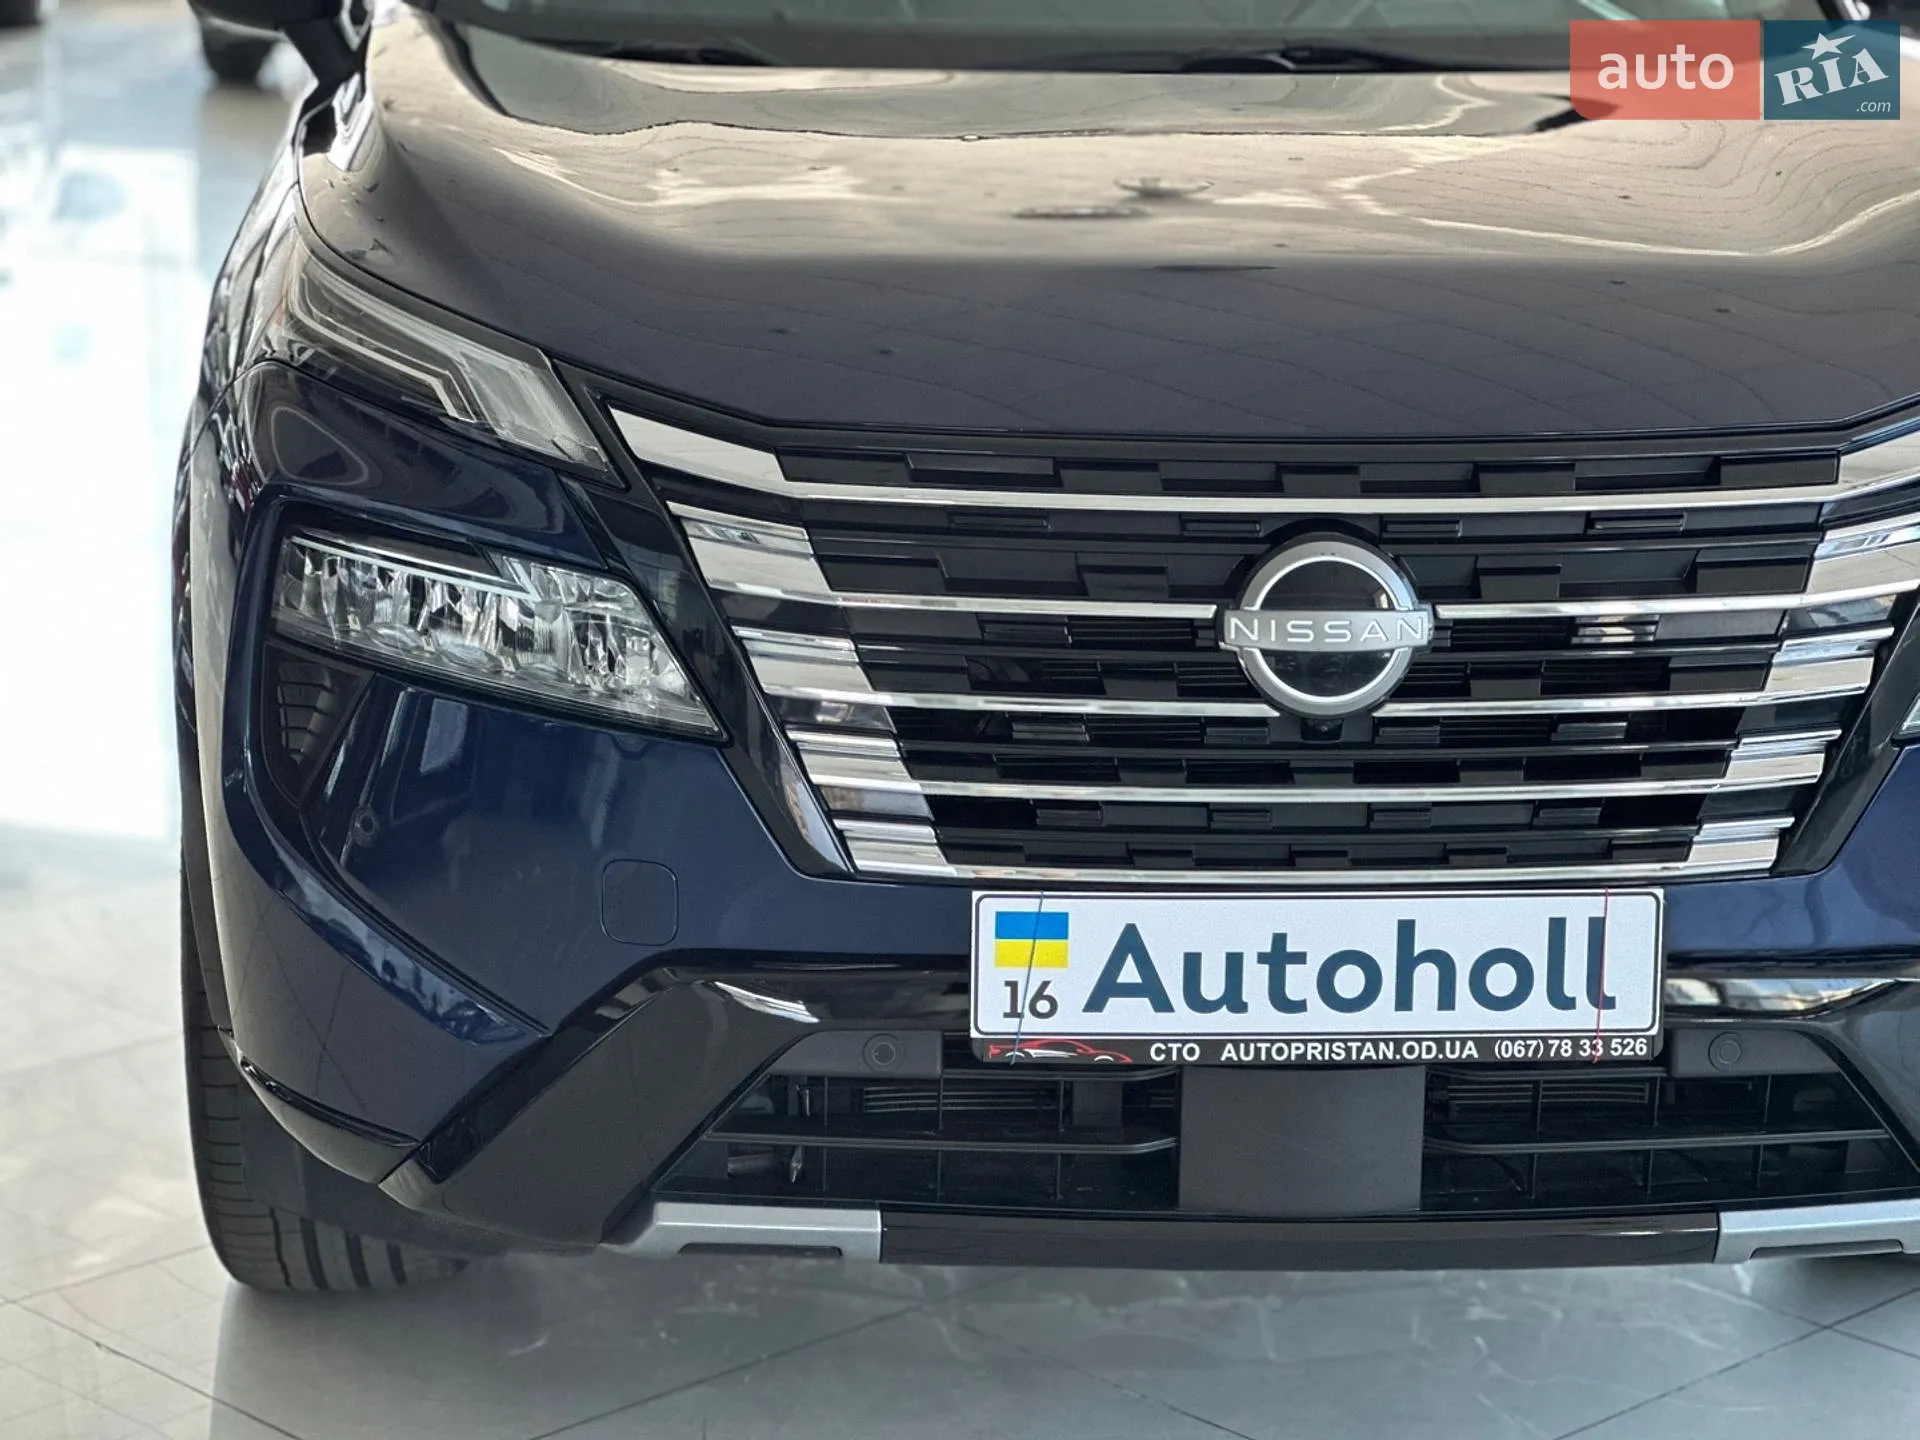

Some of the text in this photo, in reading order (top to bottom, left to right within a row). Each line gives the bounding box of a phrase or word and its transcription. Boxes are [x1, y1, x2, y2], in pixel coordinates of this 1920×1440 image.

[1229, 617, 1424, 643] NISSAN
[1082, 916, 1617, 1014] Autoholl
[1003, 980, 1059, 1019] 16
[1220, 1041, 1478, 1062] AUTOPRISTAN.OD.UA
[1494, 1040, 1543, 1059] (067)
[1549, 1039, 1572, 1057] 78
[1579, 1038, 1603, 1057] 33
[1610, 1037, 1648, 1056] 526
